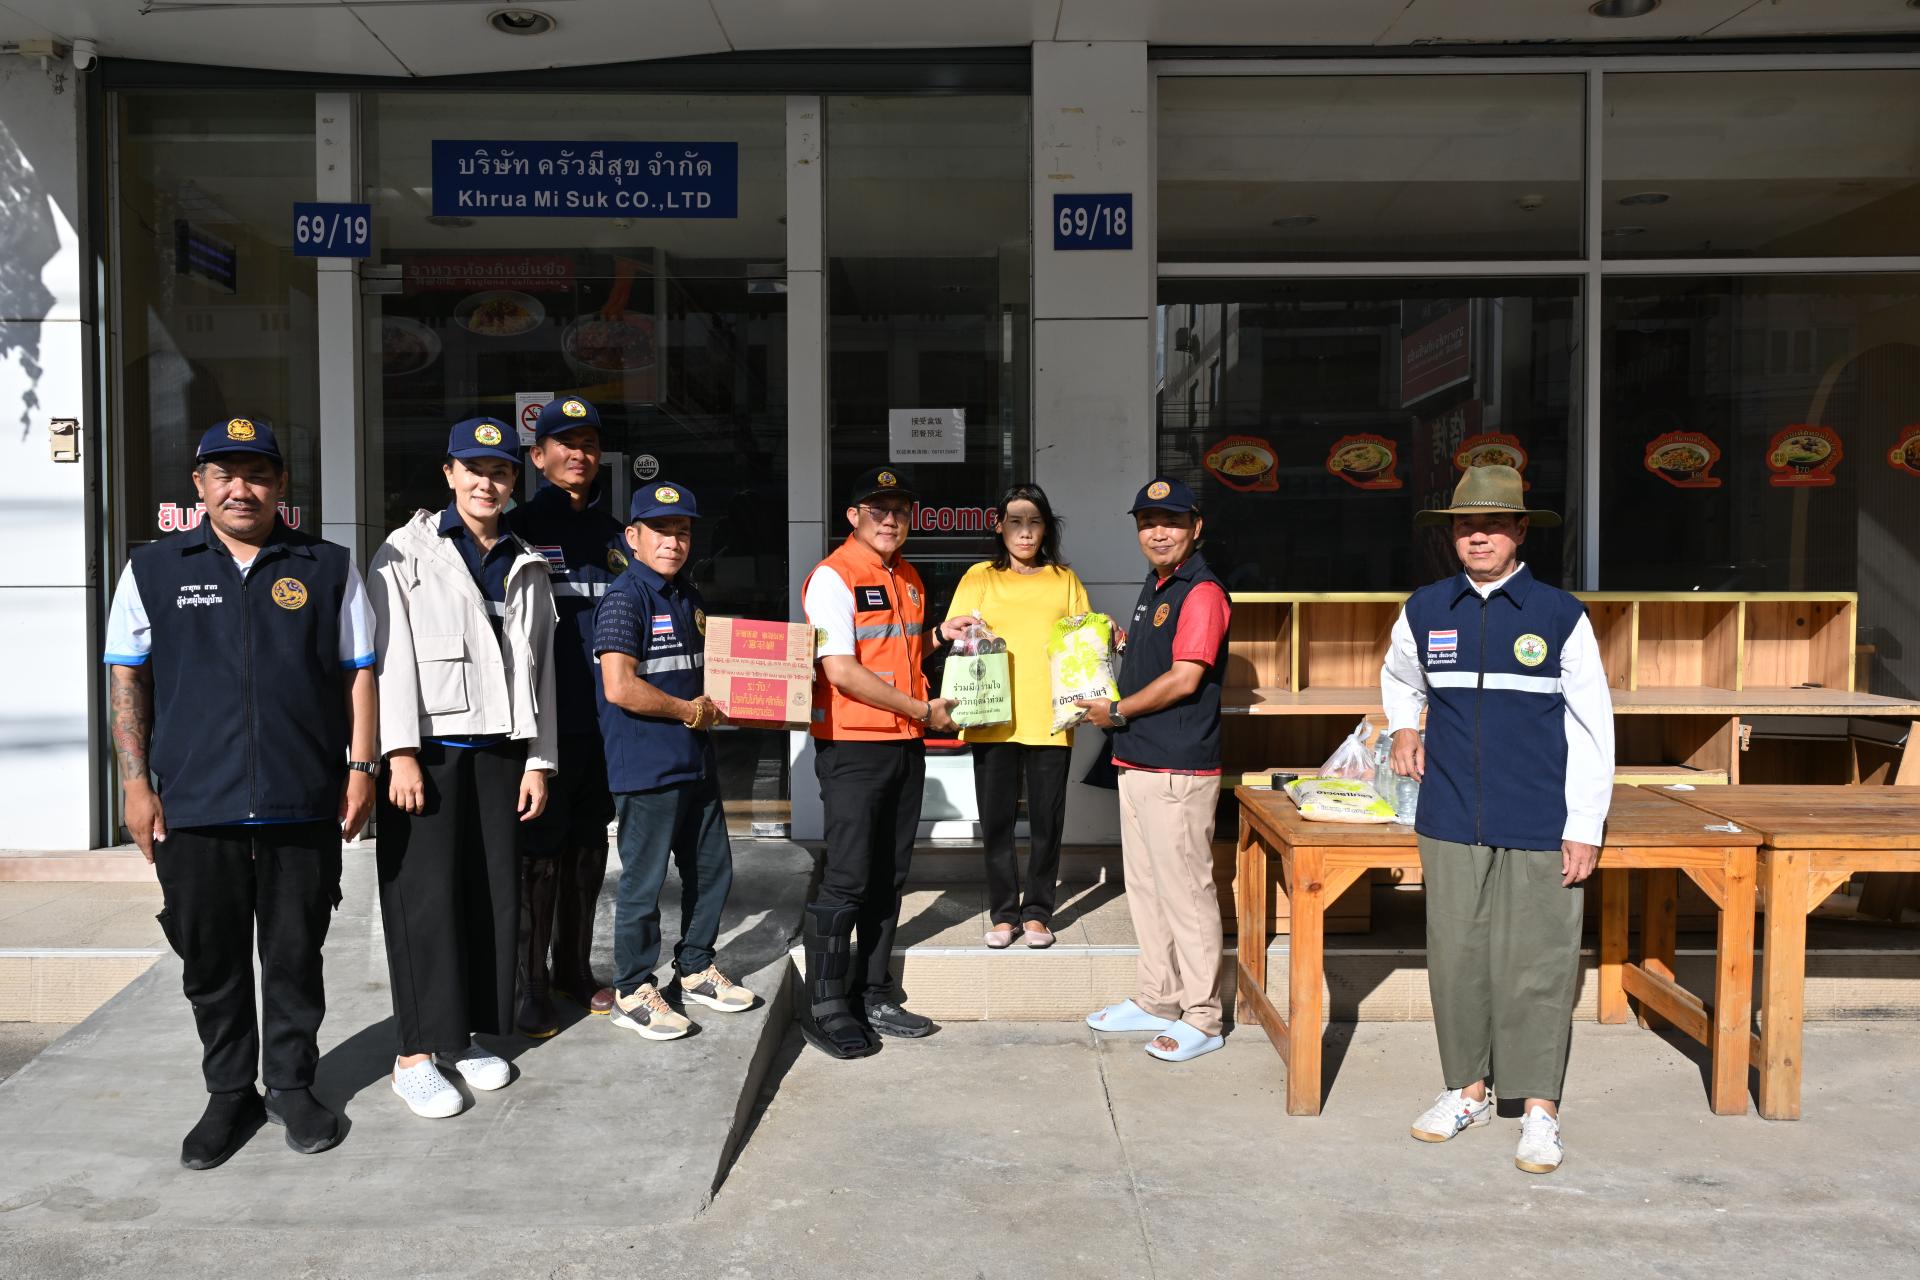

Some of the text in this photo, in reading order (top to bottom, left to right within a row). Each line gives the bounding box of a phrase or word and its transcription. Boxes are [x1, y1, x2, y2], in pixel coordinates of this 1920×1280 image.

[458, 149, 712, 185] บริษัท ครัวมีสุข จำกัด
[458, 189, 712, 211] Khrua Mi Suk CO.,LTD
[296, 213, 368, 249] 69/19
[1059, 204, 1127, 241] 69/18
[911, 501, 998, 531] lcome
[177, 594, 223, 608] ผู้ช่วยผู้ใหญ่บ้าน
